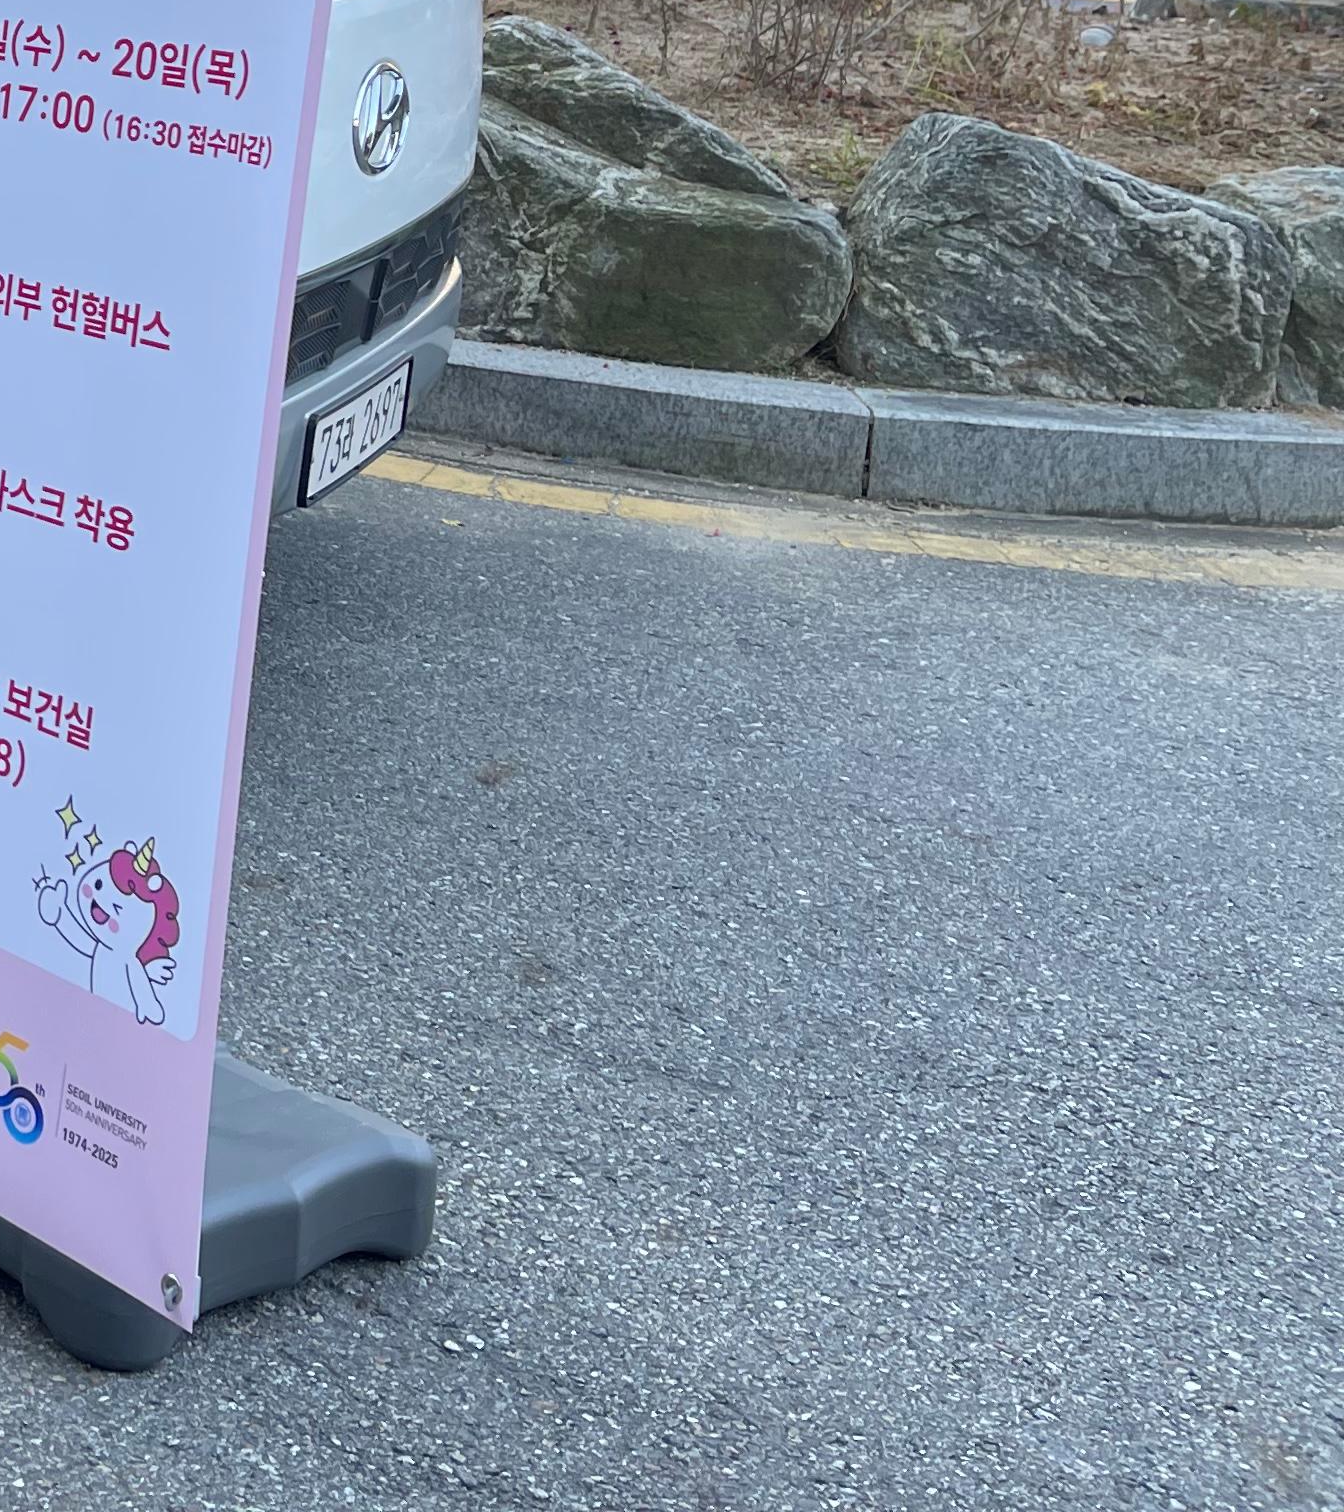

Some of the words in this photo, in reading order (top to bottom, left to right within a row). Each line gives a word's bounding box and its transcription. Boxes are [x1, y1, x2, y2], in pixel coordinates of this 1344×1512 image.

[78, 48, 101, 64] ~
[112, 38, 250, 101] 20일(목)
[0, 82, 95, 134] 17:00
[103, 109, 181, 149] (16:30
[187, 123, 274, 169] 접수마감)
[50, 286, 173, 352] 헌혈버스
[359, 378, 402, 454] 2697
[73, 495, 136, 552] 착용
[3, 679, 95, 751] 보건실
[67, 1082, 92, 1107] SEOIL
[94, 1096, 148, 1135] UNIVERSITY
[85, 1110, 148, 1151] ANNIVERSARY
[63, 1127, 119, 1169] 1974-2025
